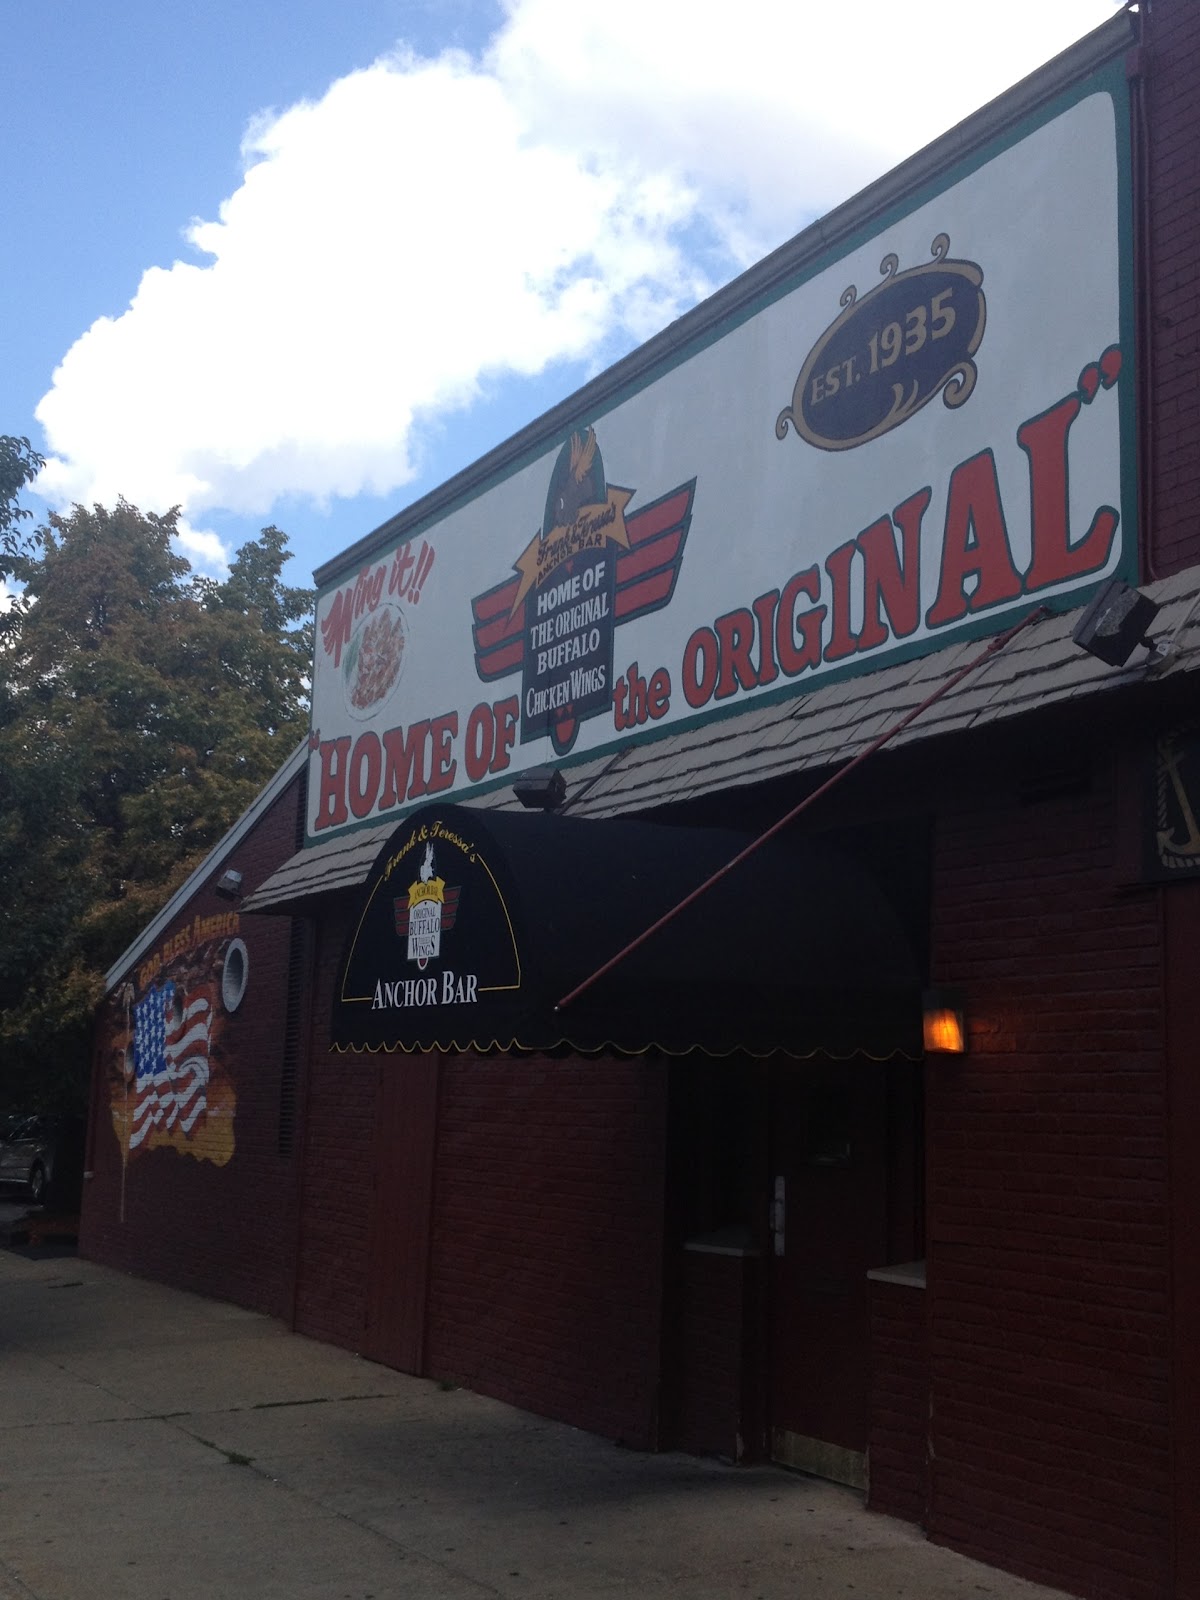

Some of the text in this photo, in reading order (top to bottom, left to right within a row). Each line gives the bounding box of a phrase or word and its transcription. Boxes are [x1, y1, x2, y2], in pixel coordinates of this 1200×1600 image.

[809, 288, 957, 407] EST. 1935
[537, 533, 603, 585] ANCHOR BAR
[537, 561, 606, 616] HOME OF
[321, 564, 387, 670] Wing
[530, 592, 610, 650] THE ORIGINAL
[537, 628, 600, 675] BUFFALO
[464, 694, 519, 783] OF
[613, 661, 671, 732] the
[384, 830, 417, 881] Frank
[417, 824, 429, 842] &
[409, 918, 440, 936] BUFFALO
[413, 907, 436, 919] ORIGINAL
[412, 935, 436, 957] WINGS
[371, 971, 478, 1010] ANCHOR BAR
